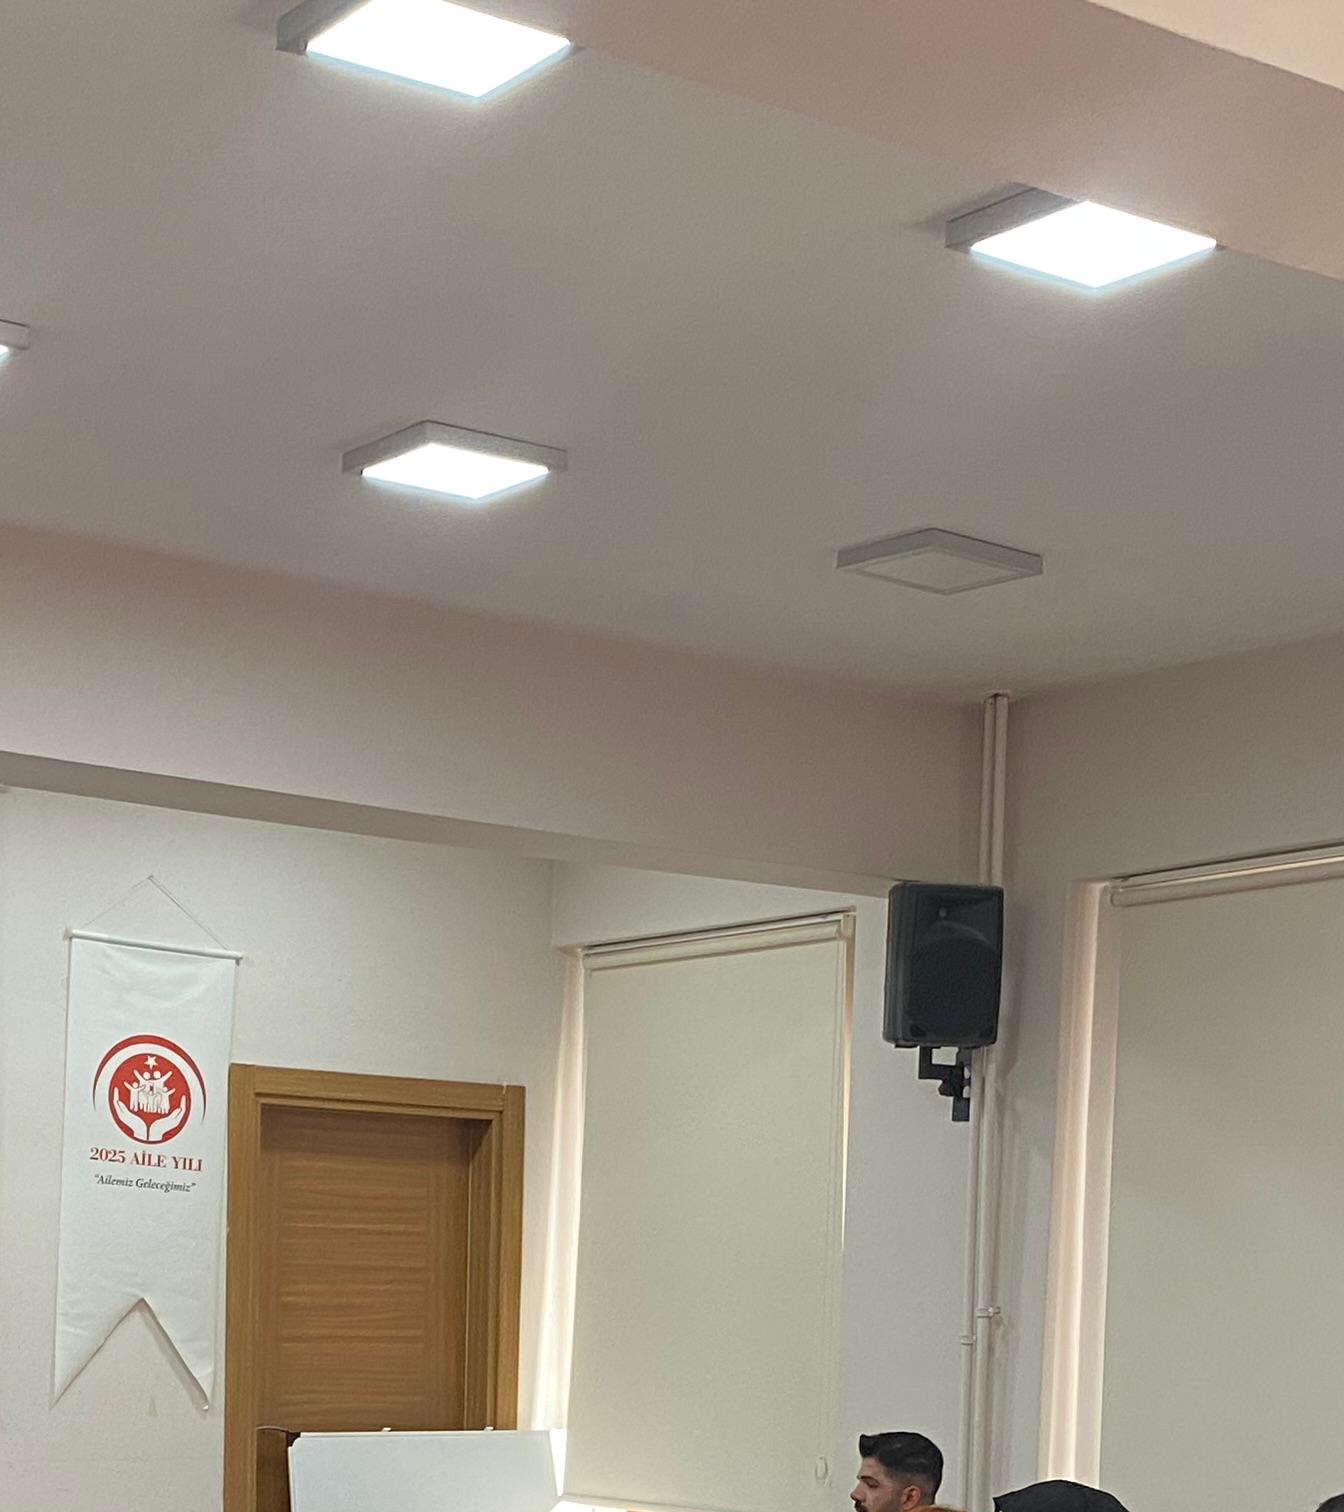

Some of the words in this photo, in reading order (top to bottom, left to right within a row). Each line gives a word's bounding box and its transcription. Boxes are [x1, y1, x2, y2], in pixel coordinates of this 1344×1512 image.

[90, 1147, 126, 1163] 2025
[131, 1150, 167, 1168] AİLE
[172, 1156, 203, 1172] YILI
